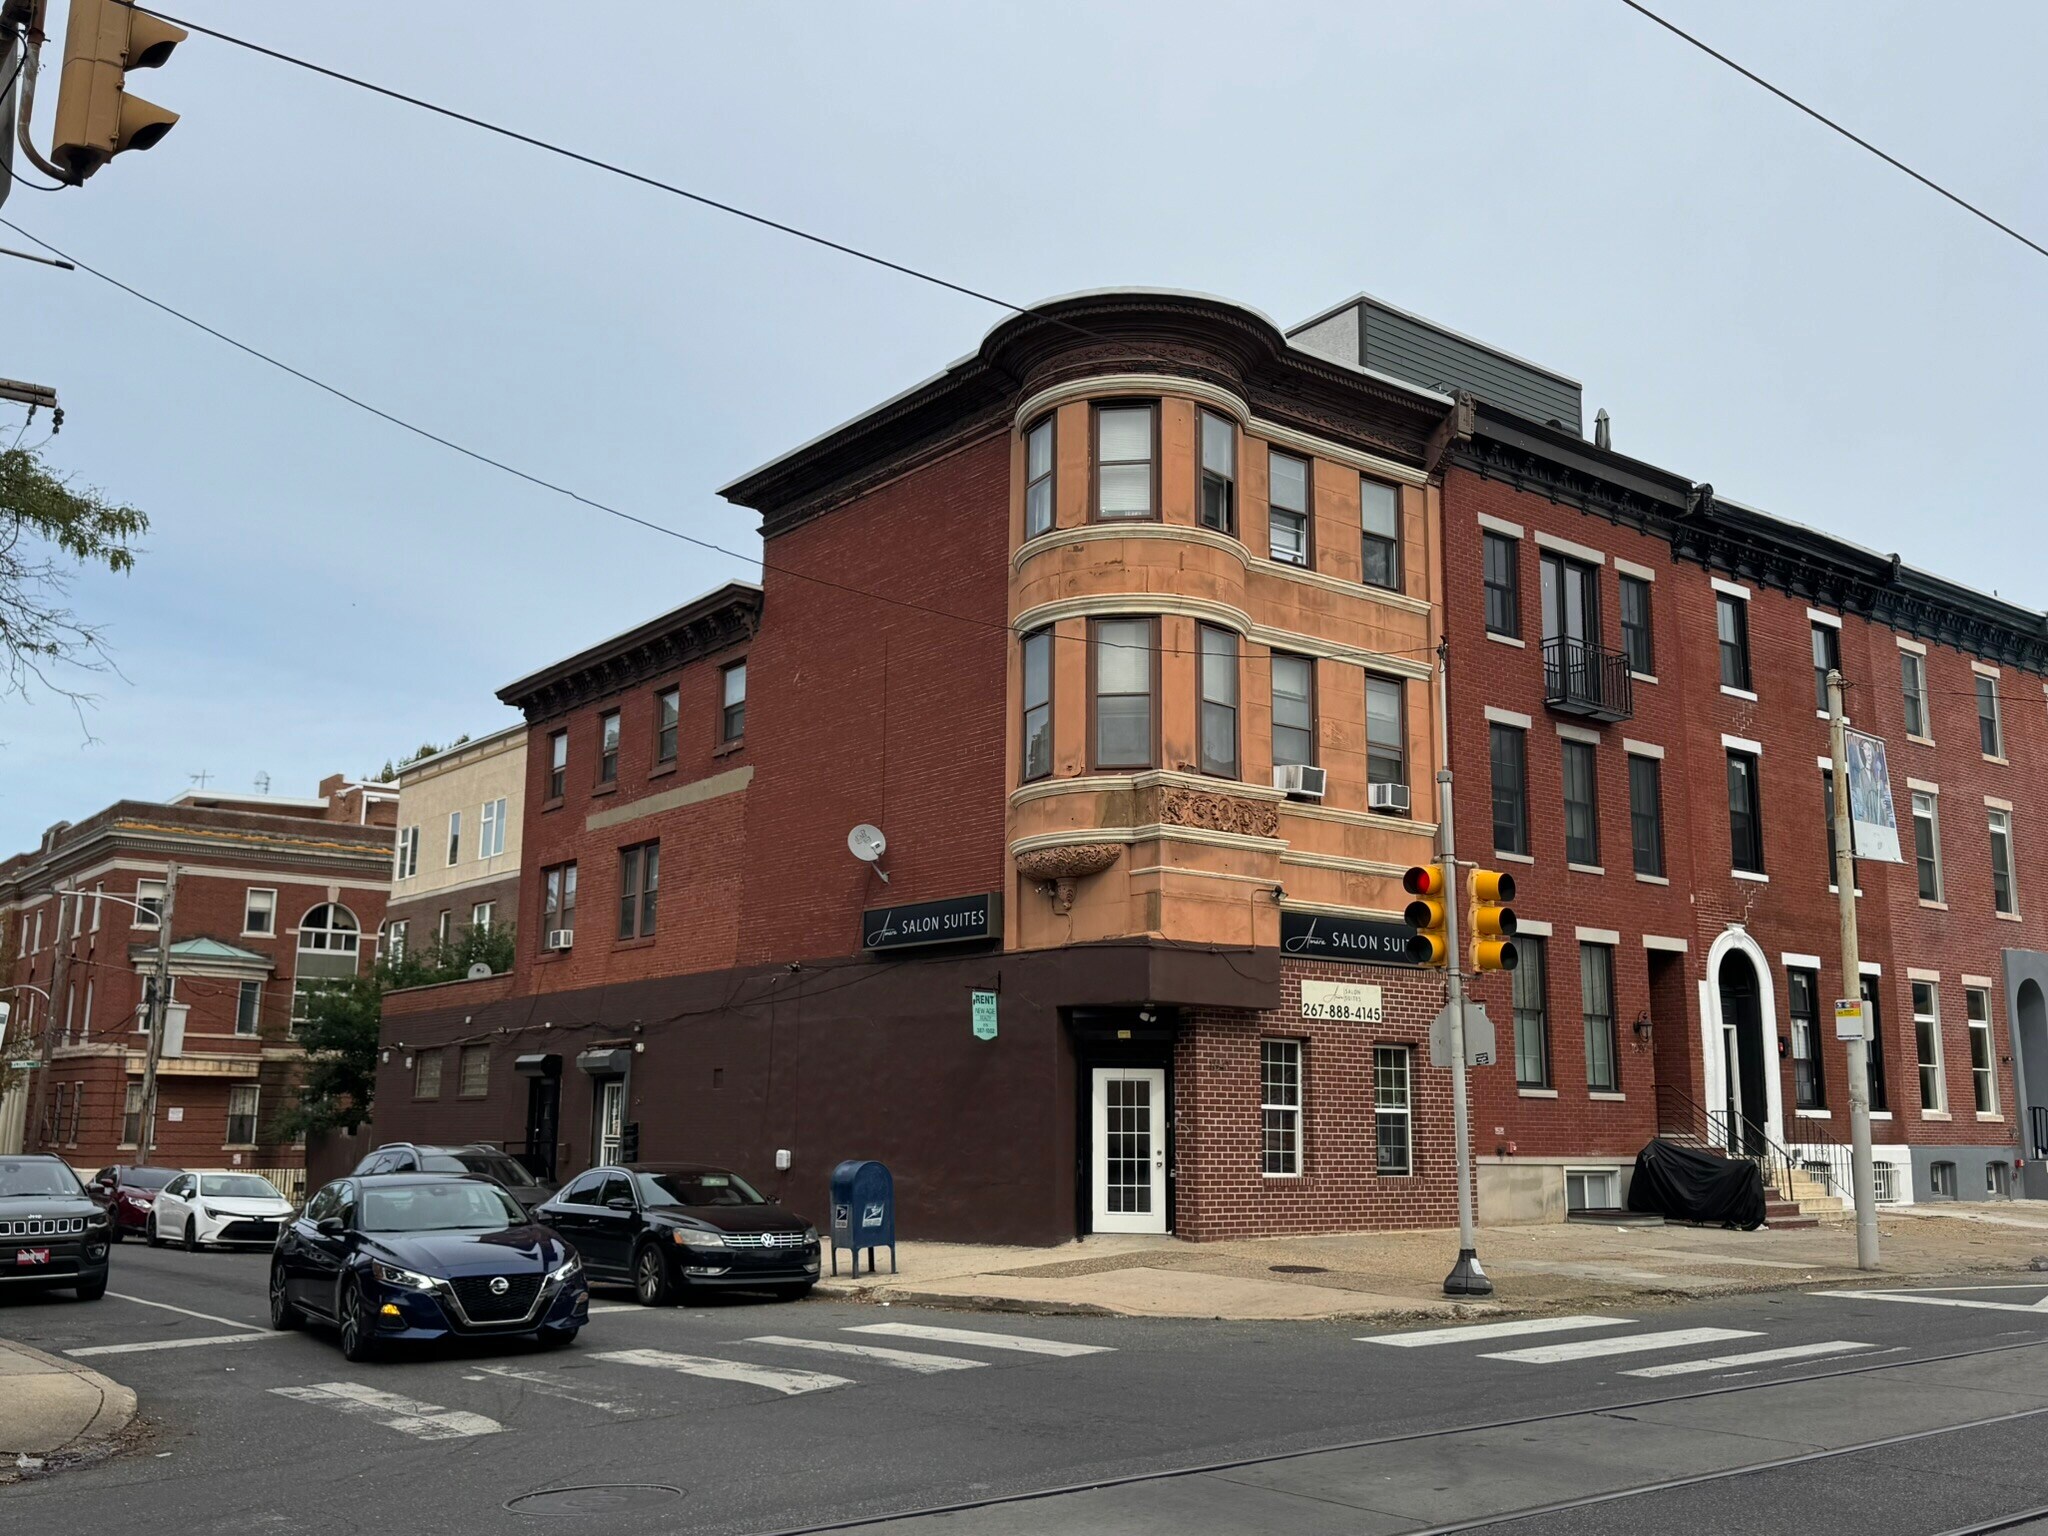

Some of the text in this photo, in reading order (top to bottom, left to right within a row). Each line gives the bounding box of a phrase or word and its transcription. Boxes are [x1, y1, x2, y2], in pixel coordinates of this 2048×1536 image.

[902, 916, 939, 934] SALON
[944, 910, 985, 929] SUITES
[1332, 932, 1378, 950] SALON
[1384, 937, 1410, 953] SUI
[975, 995, 994, 1005] RENT
[1303, 1003, 1381, 1021] 267-888-4145
